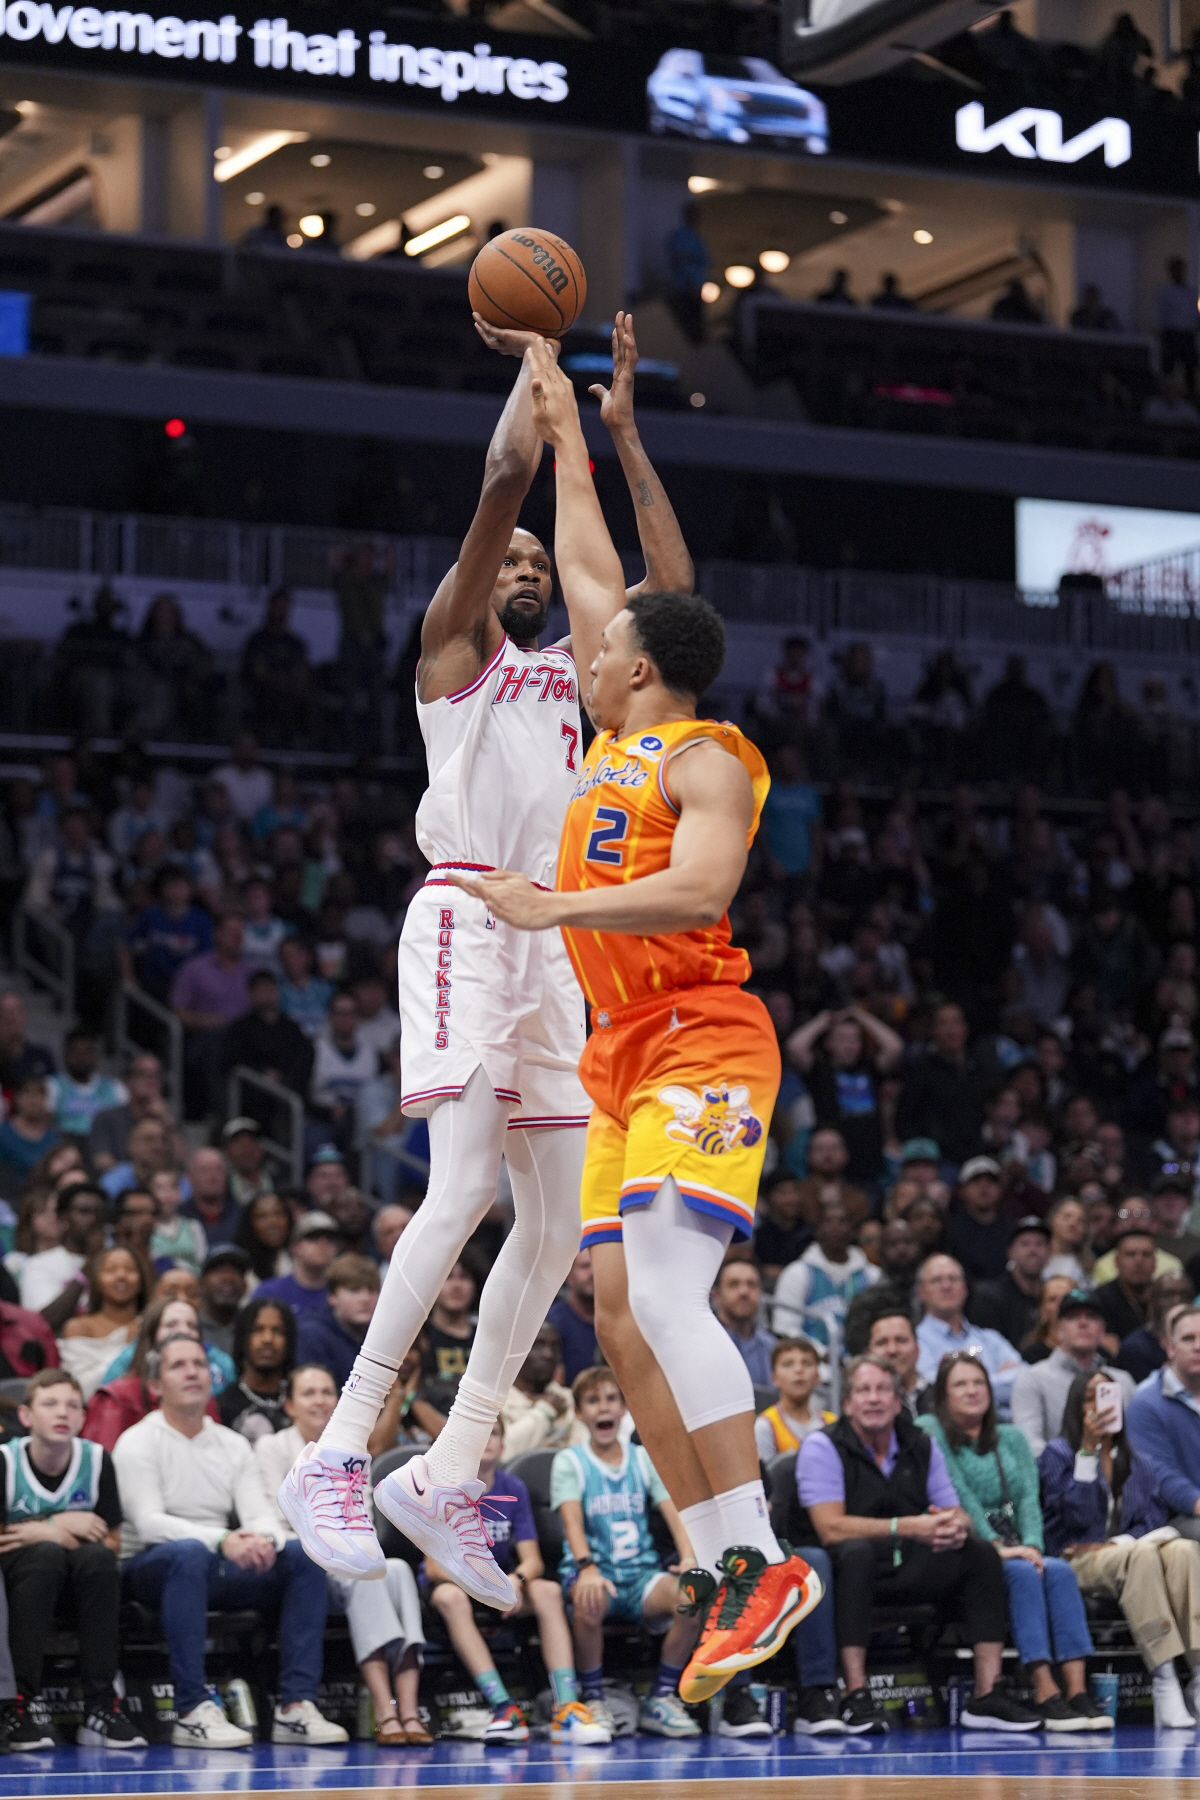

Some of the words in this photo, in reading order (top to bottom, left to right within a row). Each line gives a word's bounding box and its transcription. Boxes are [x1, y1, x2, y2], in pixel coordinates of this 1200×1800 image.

[0, 0, 241, 64] ovement
[248, 17, 361, 77] that
[368, 31, 569, 102] inspires
[511, 233, 569, 295] Wilson
[560, 719, 579, 775] 7
[585, 806, 629, 866] 2
[434, 908, 454, 1050] ROCKETS
[610, 1520, 640, 1561] 2
